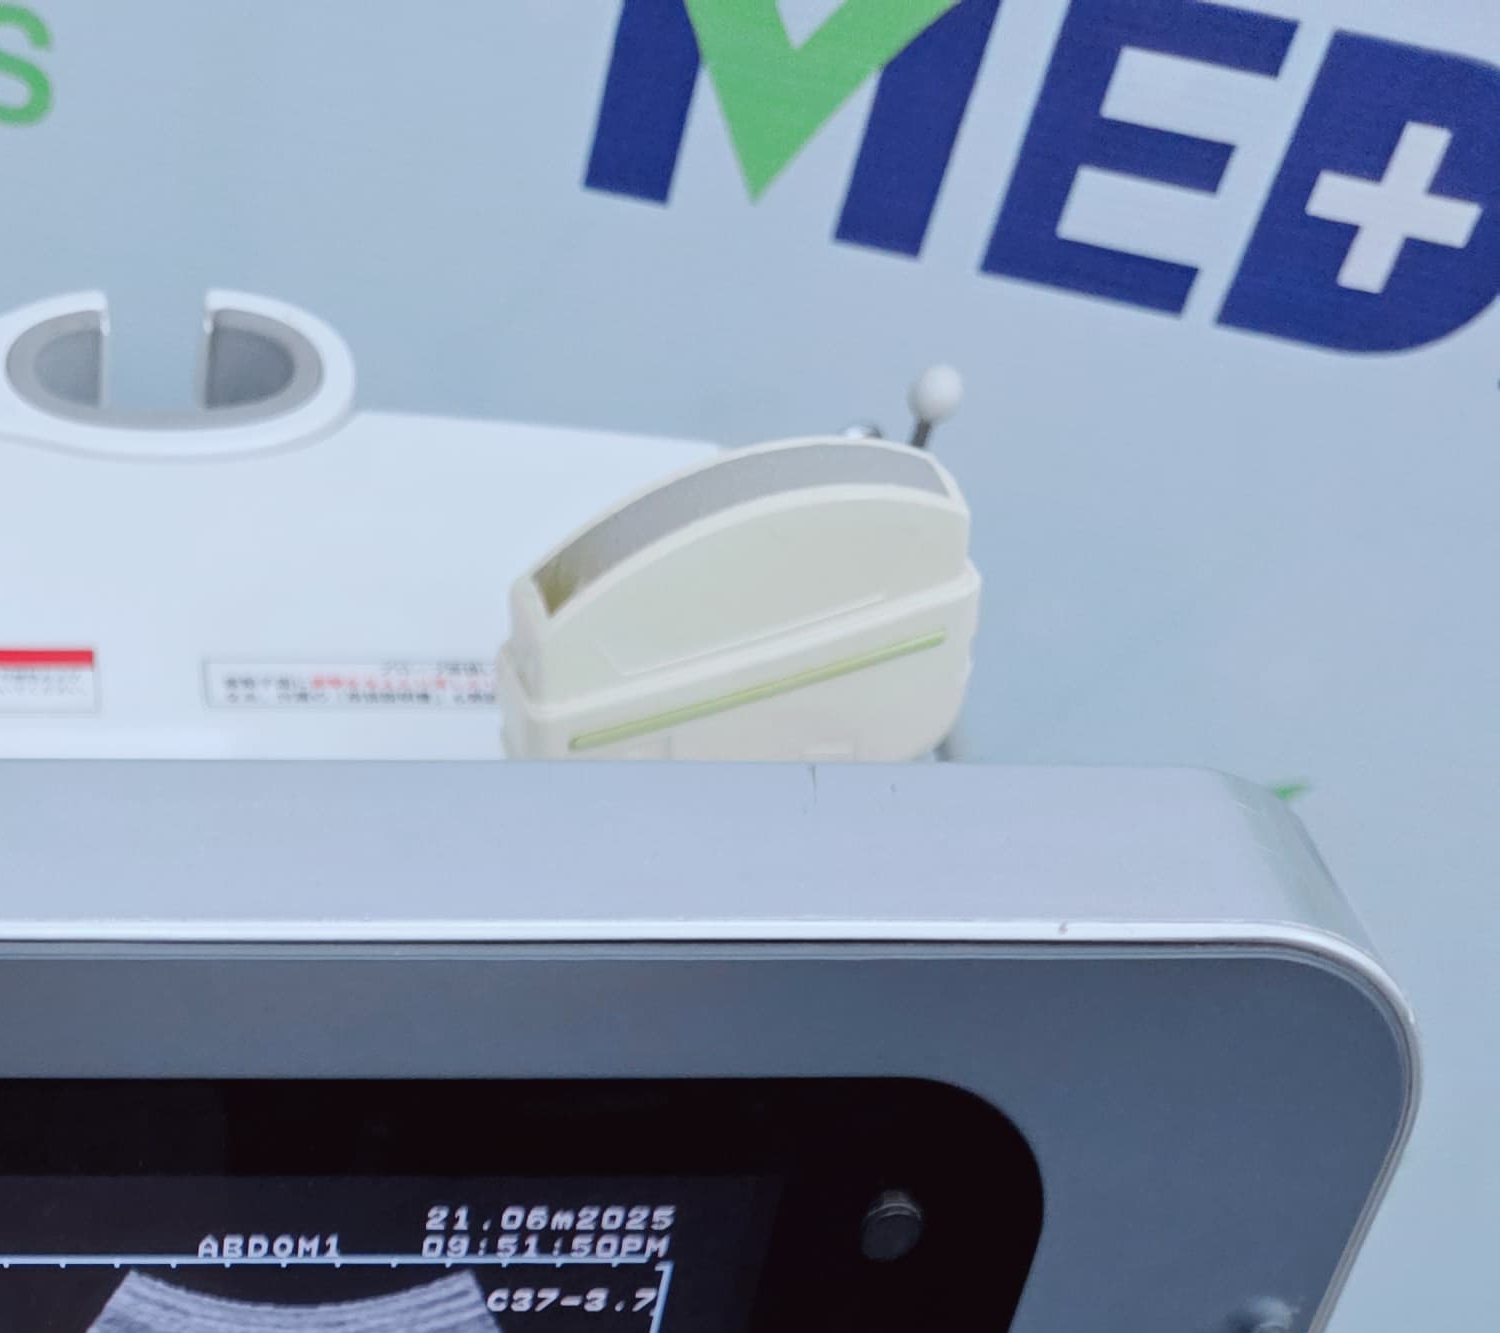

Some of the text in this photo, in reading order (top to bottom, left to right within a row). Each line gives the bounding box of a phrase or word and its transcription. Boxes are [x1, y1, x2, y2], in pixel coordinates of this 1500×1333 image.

[197, 1233, 342, 1259] ABDOM1
[421, 1234, 672, 1260] 09:51:50PM
[486, 1288, 658, 1313] C37-3.7
